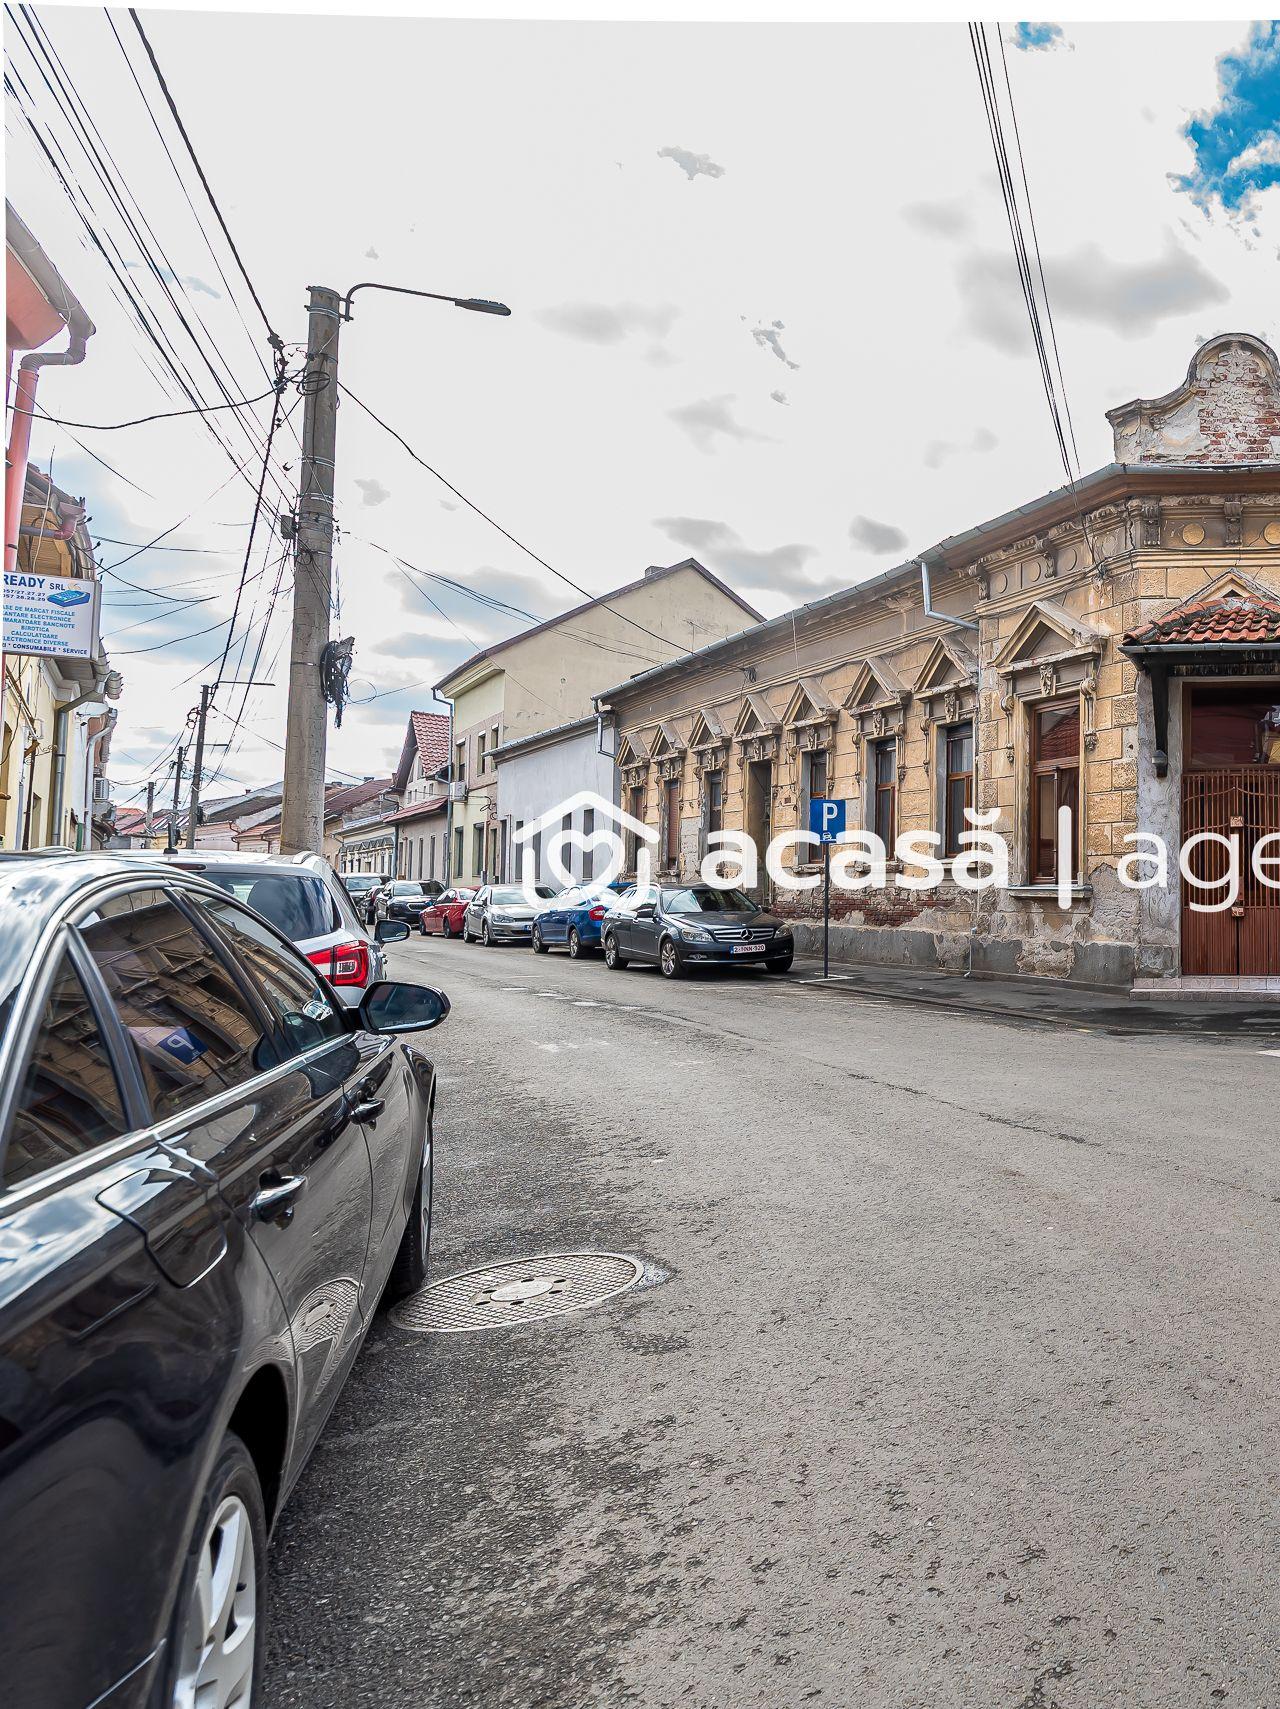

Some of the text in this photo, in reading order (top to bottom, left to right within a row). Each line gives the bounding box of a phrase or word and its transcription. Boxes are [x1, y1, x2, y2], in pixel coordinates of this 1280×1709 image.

[49, 582, 66, 591] SRL
[25, 606, 49, 614] MARCAT
[30, 614, 72, 623] ELECTRONICE
[11, 630, 58, 639] CALCULATOARE
[12, 644, 57, 652] CONSUMABILE
[62, 647, 88, 655] SERVICE
[822, 802, 838, 831] P
